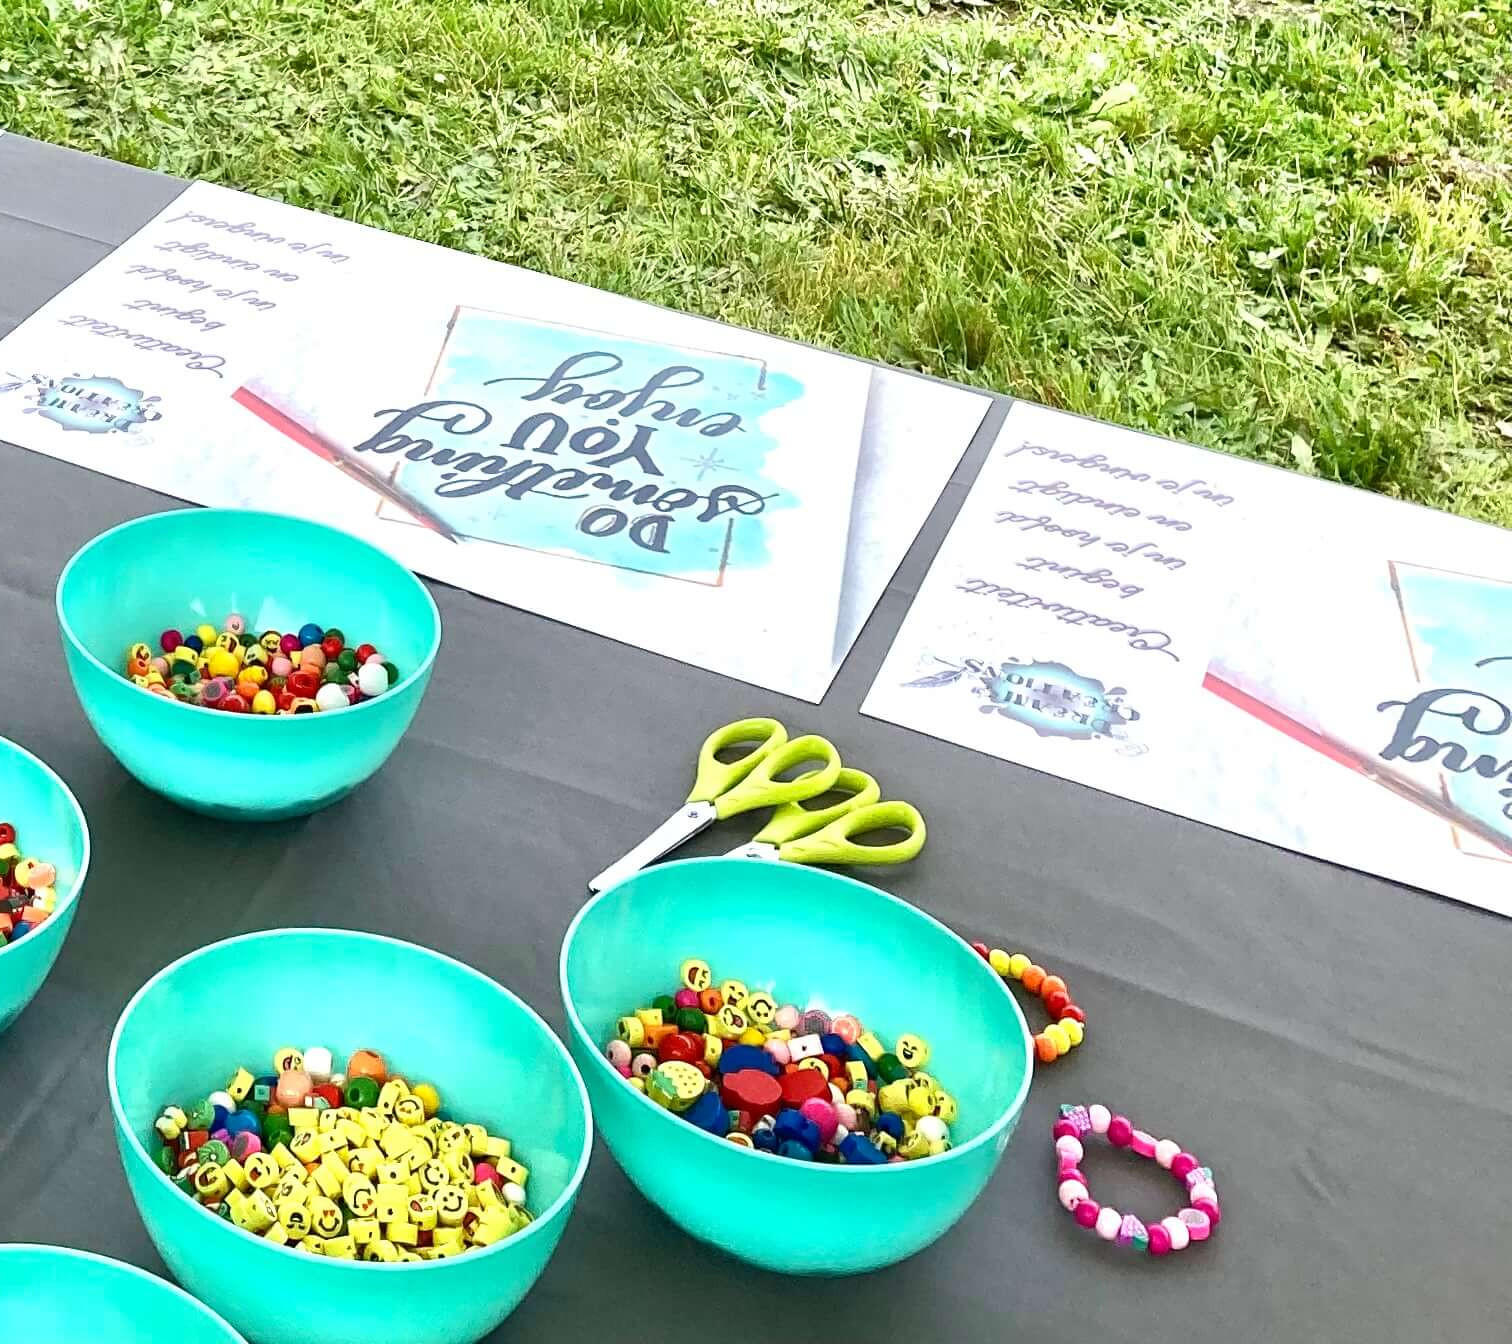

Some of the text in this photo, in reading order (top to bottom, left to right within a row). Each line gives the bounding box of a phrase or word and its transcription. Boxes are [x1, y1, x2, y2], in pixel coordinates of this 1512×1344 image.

[154, 240, 300, 283] en eindigt
[287, 240, 333, 255] je
[316, 250, 351, 264] in
[124, 263, 278, 311] in je hoofd
[122, 298, 228, 332] begint
[58, 313, 227, 379] Creativiteit
[483, 351, 747, 437] enjoy
[1003, 441, 1235, 507] in je vingers!
[575, 504, 676, 553] DO
[1008, 479, 1194, 532] en eindigt
[994, 511, 1188, 570] in je hoofd
[1015, 557, 1145, 599] begint
[956, 577, 1181, 663] Creativiteit
